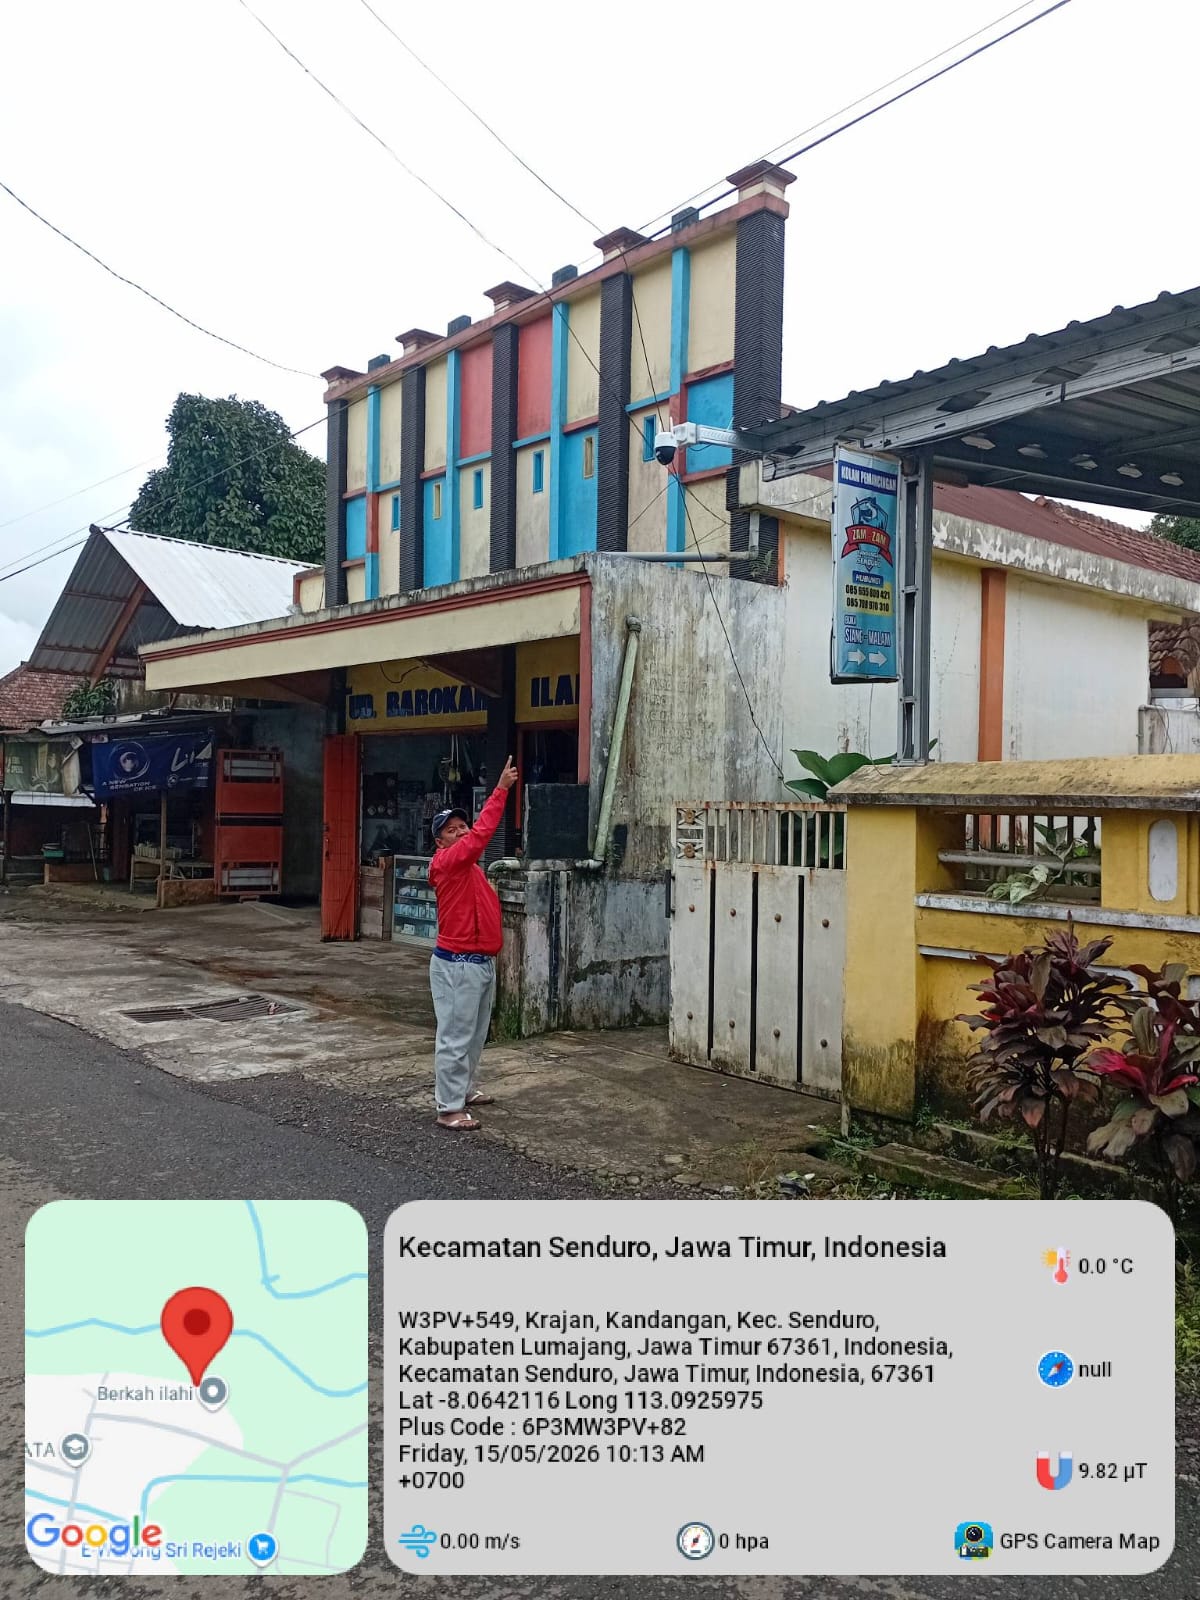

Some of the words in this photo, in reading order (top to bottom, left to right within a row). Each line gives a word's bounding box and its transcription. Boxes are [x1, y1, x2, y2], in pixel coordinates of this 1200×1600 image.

[852, 528, 867, 541] ZAM
[871, 531, 887, 546] ZAM
[868, 630, 891, 647] MALAM
